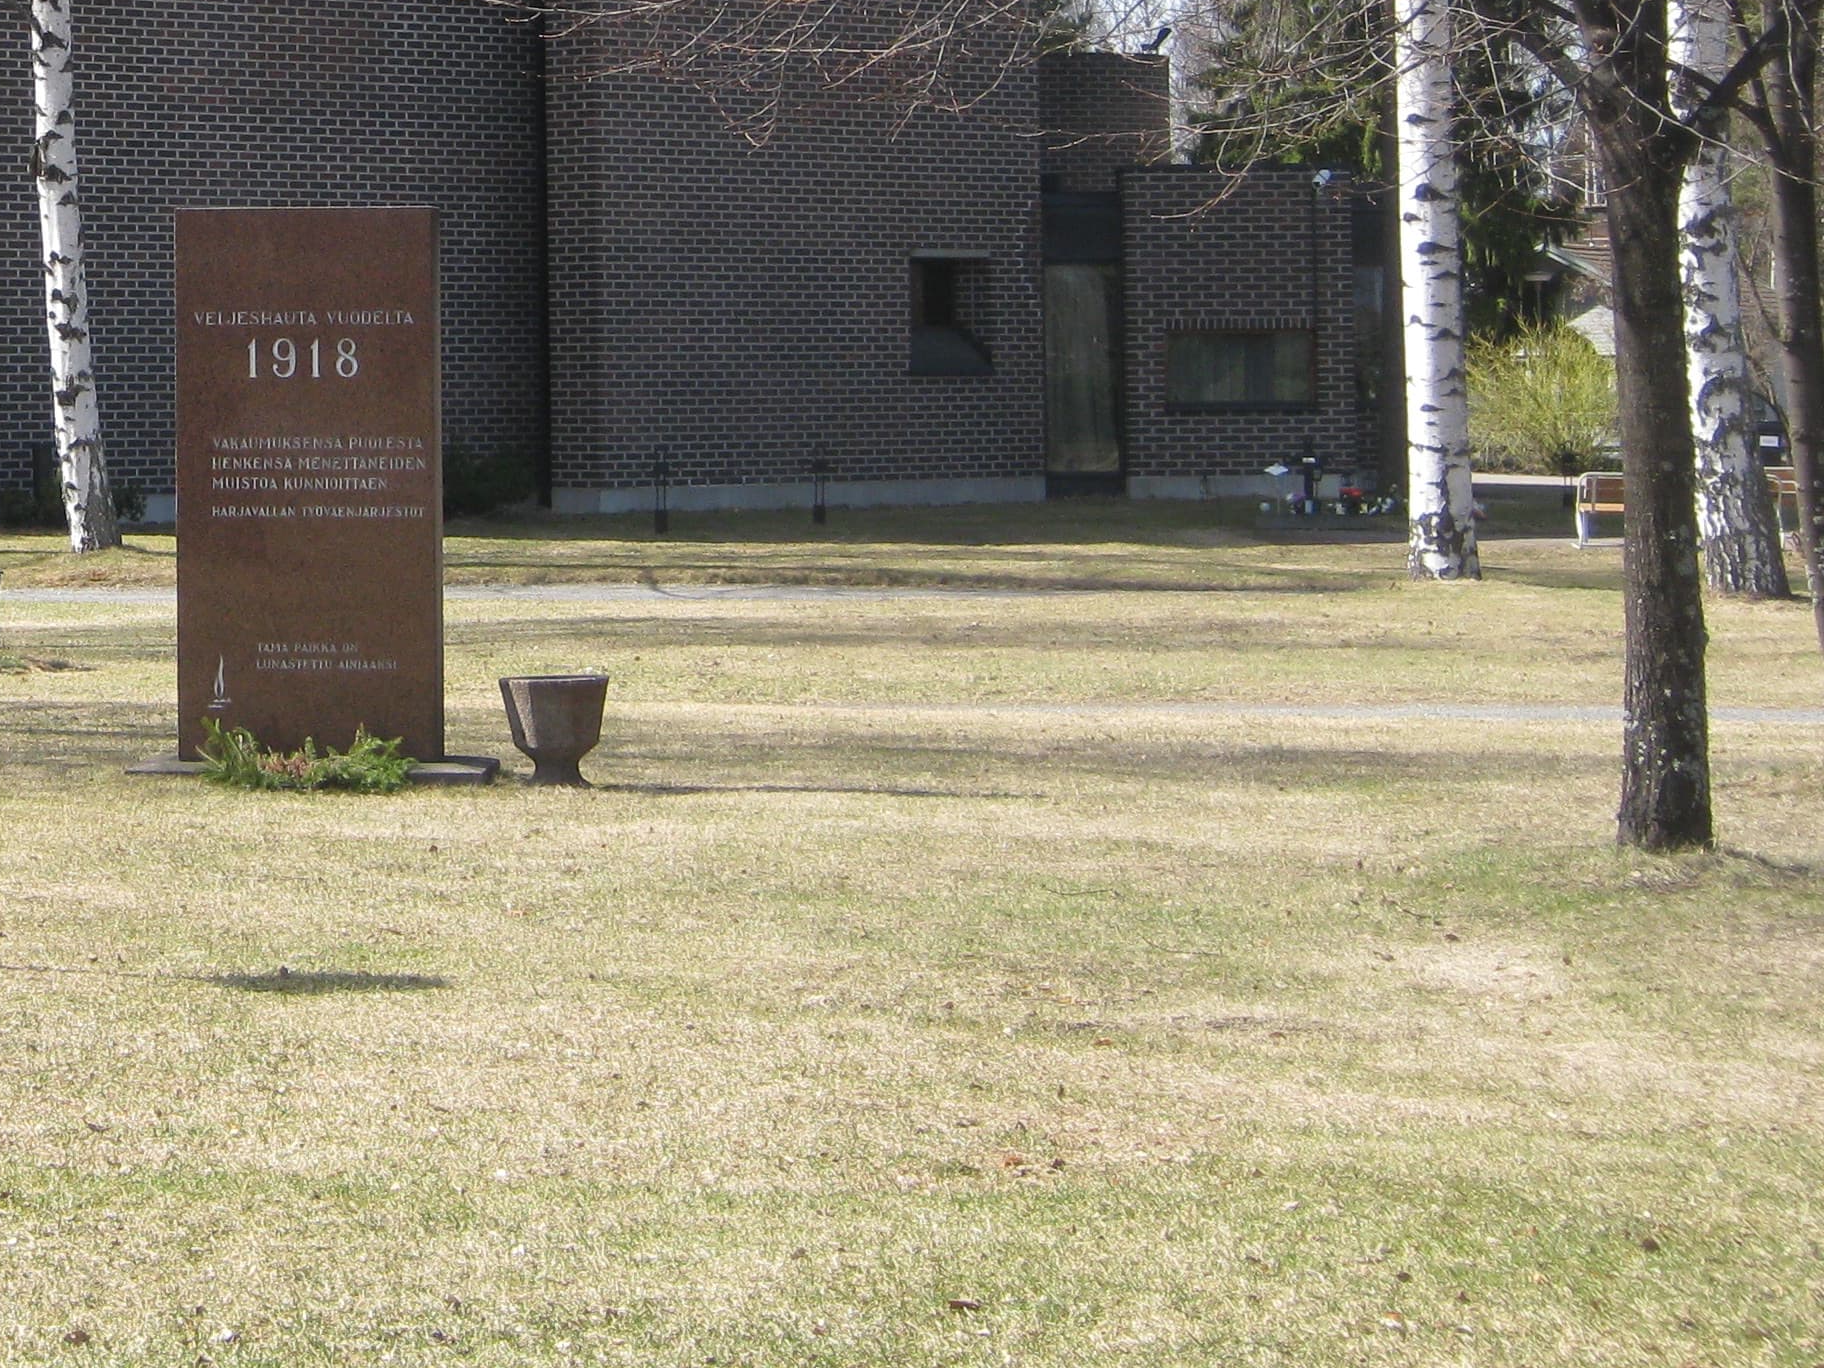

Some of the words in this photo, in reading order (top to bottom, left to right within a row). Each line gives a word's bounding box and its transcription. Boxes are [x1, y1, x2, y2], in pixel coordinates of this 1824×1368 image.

[193, 310, 317, 327] VELJESHAUTA
[326, 309, 415, 325] VUODELTA
[247, 336, 359, 379] 1918
[211, 476, 278, 491] MUISTOA
[211, 504, 296, 518] HARJAVALLAN
